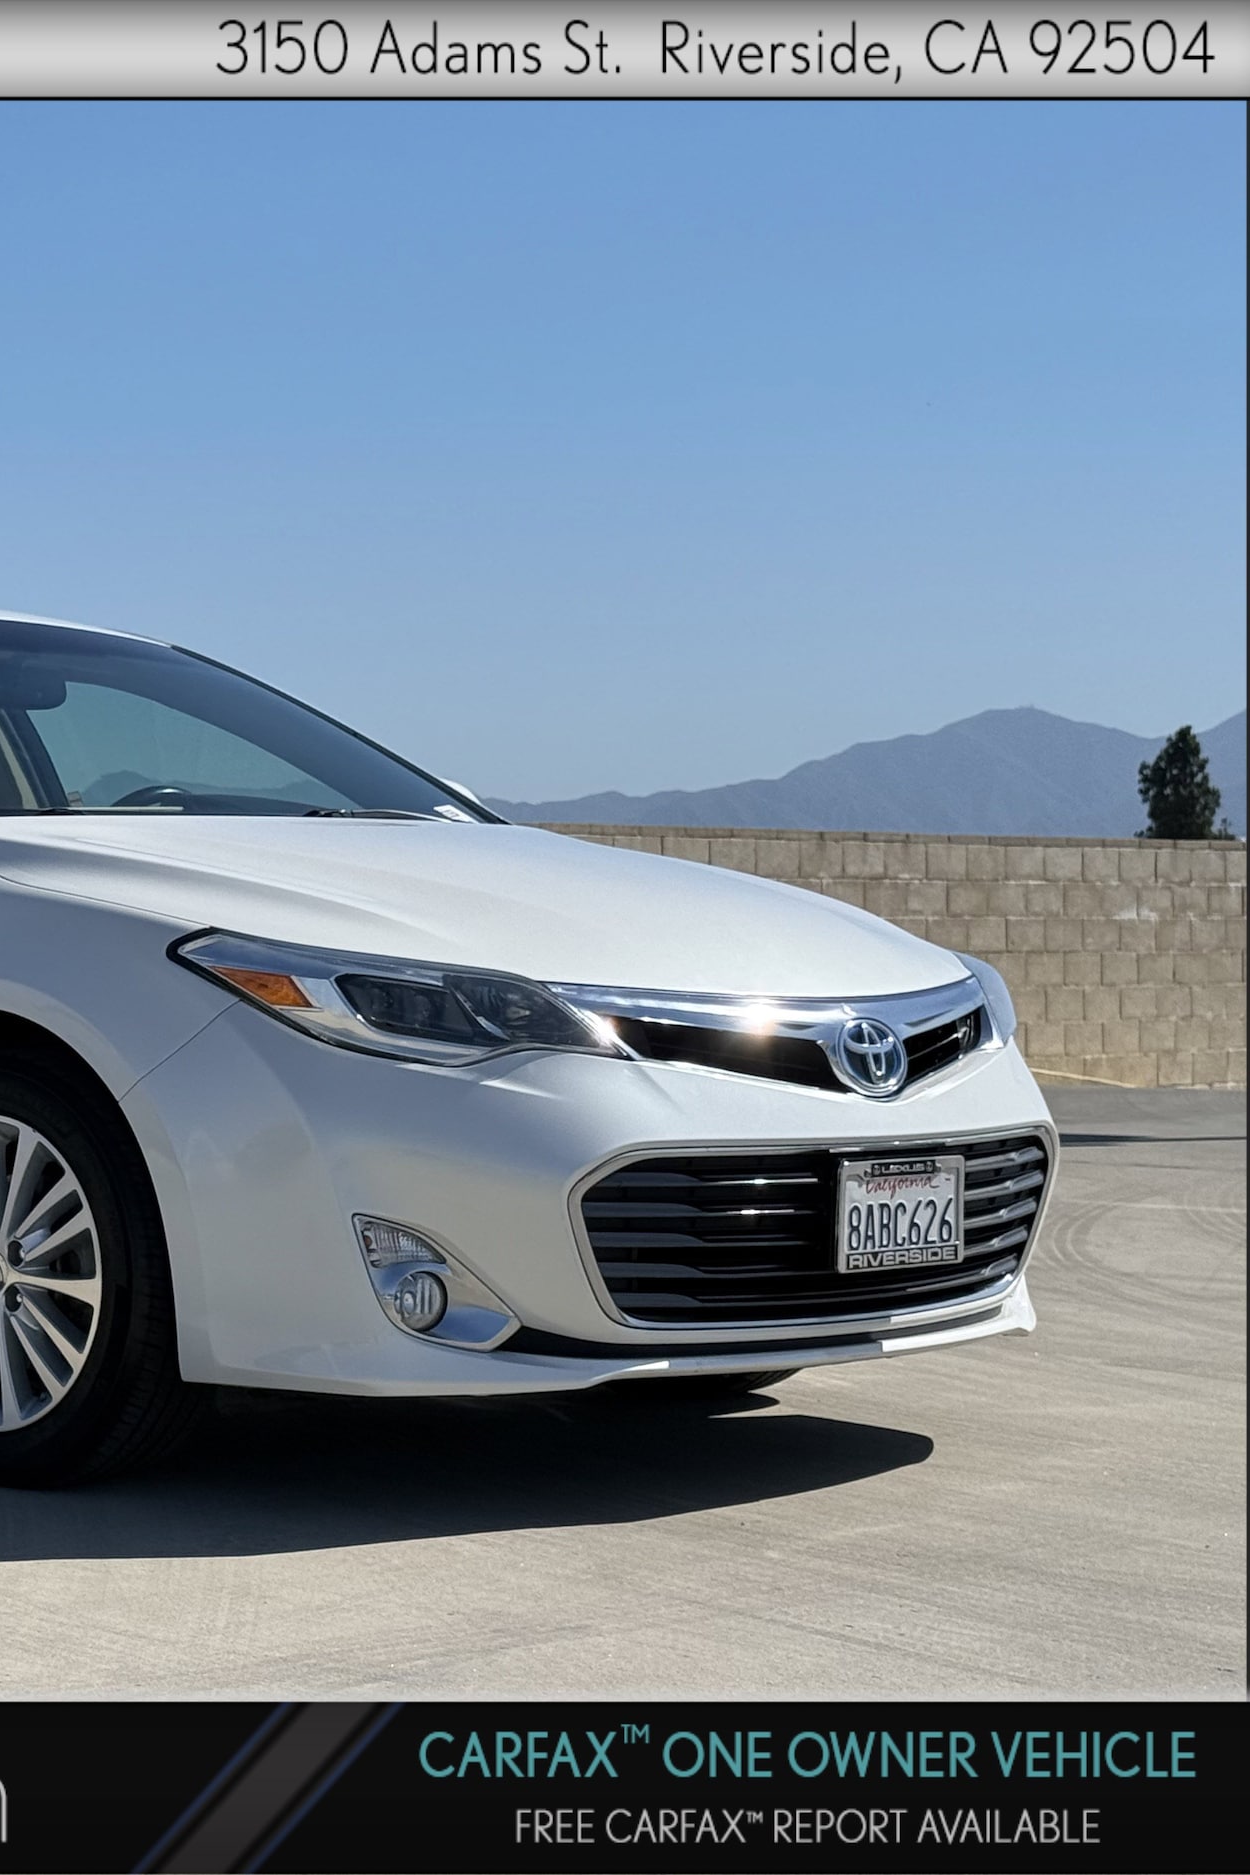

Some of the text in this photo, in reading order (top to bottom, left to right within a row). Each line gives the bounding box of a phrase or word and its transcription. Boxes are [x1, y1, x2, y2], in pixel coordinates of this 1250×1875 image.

[882, 1164, 926, 1174] LEXUS
[865, 1175, 940, 1200] California
[849, 1197, 954, 1251] 8ABC626
[849, 1246, 957, 1269] RIVERSIDE
